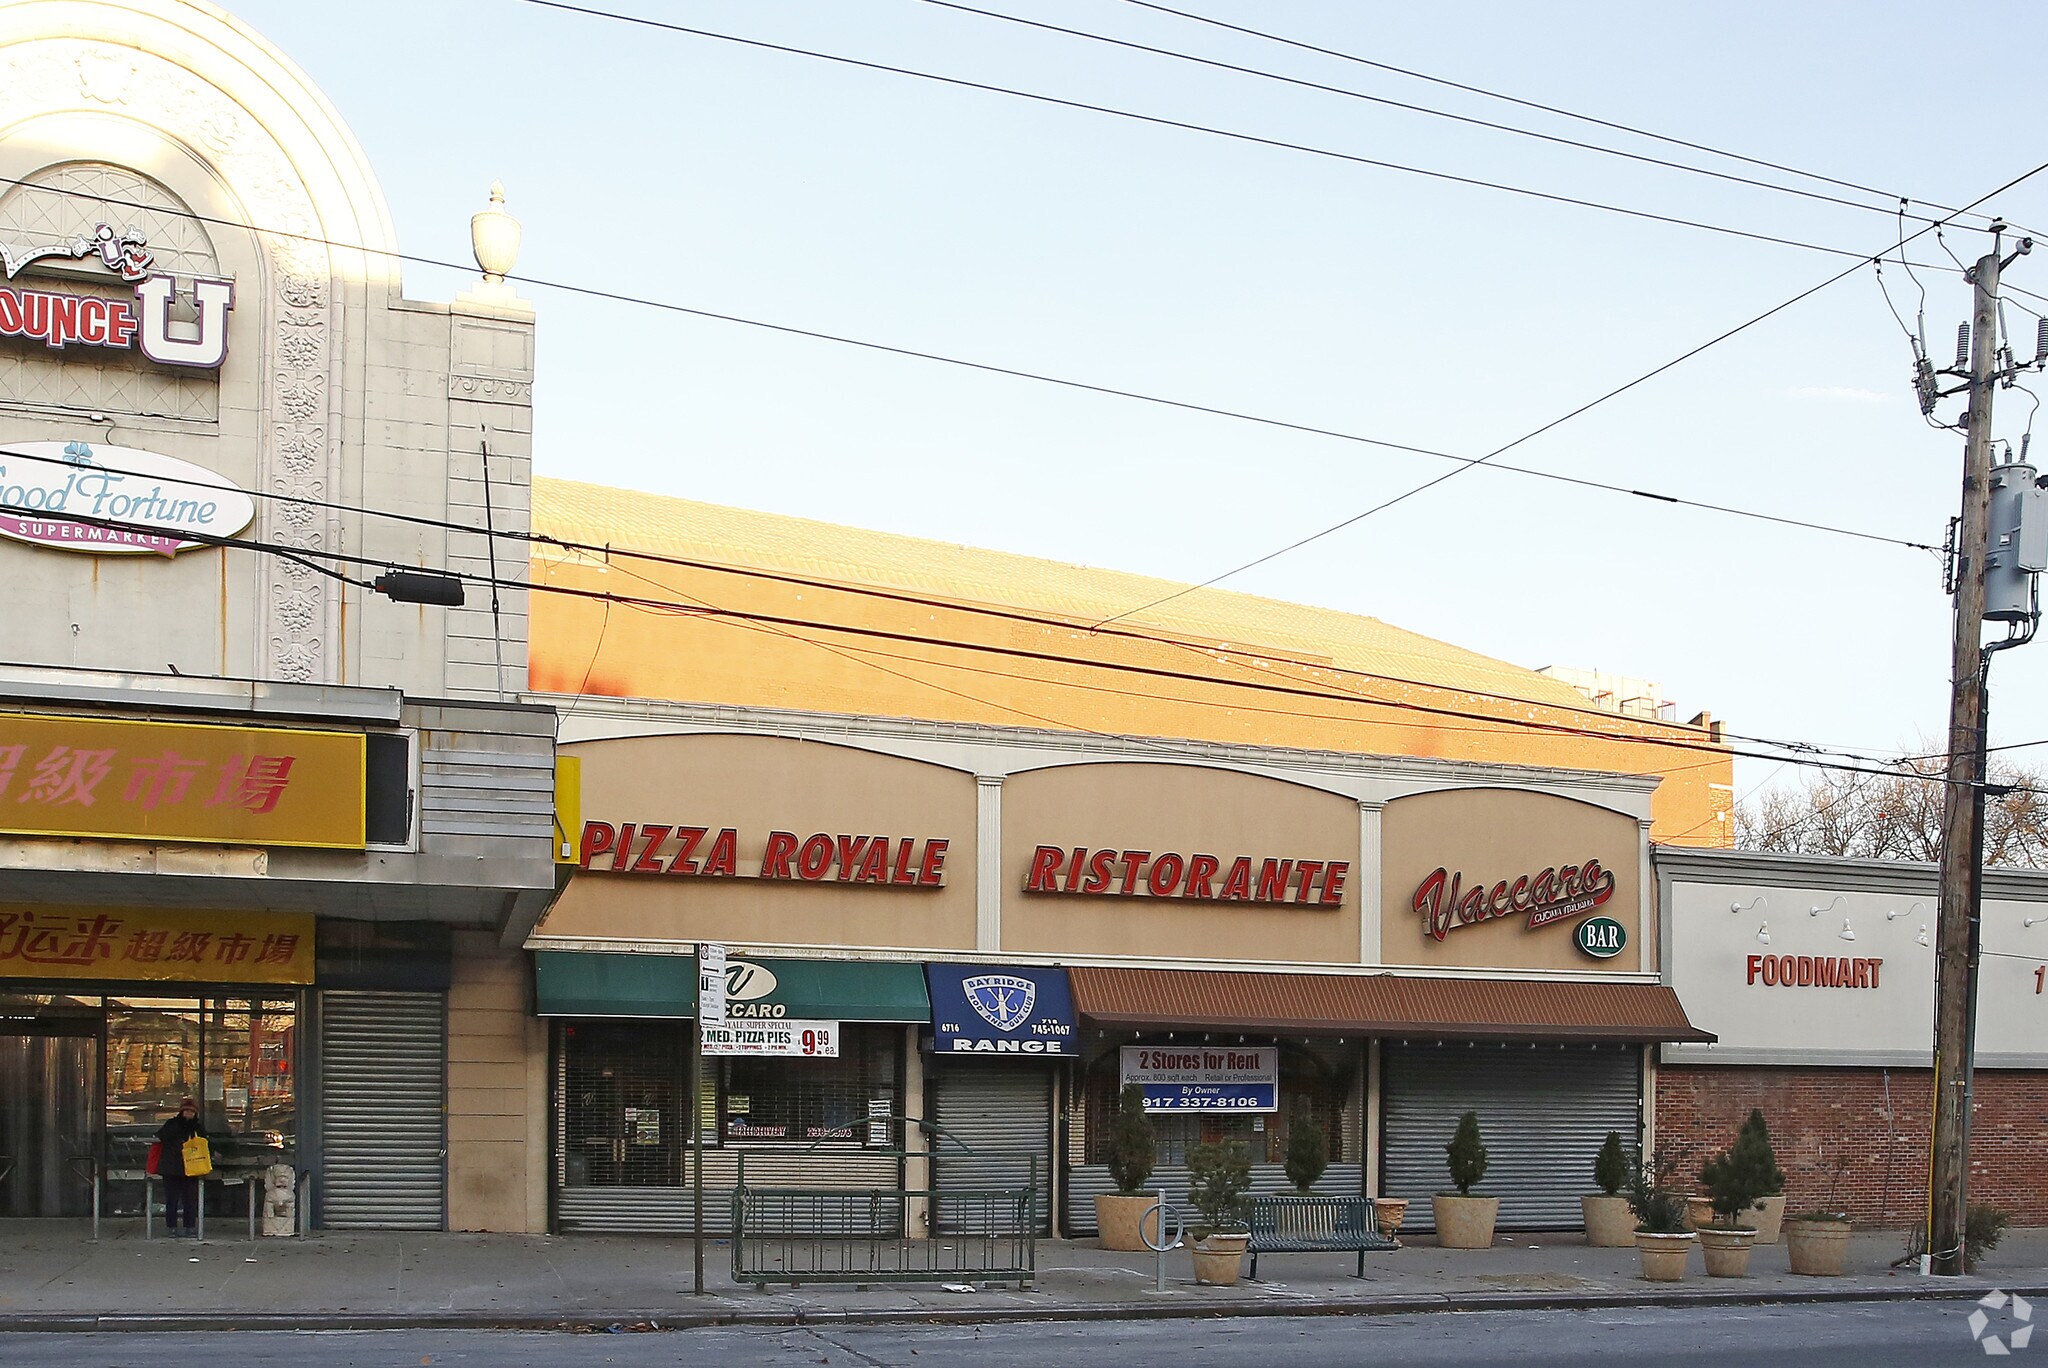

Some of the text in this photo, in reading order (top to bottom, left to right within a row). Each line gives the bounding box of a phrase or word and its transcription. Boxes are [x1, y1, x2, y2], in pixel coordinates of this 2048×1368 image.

[136, 275, 234, 367] U
[0, 466, 216, 524] ood Fortune
[18, 521, 172, 546] SUPERMARKET
[0, 745, 296, 814] 級市場
[581, 820, 949, 887] PIZZA ROYALE
[1027, 845, 1351, 907] RISTORANTE
[1412, 858, 1615, 942] Vaccaro
[1586, 924, 1620, 949] BAR
[1747, 954, 1883, 989] FOODMART
[967, 977, 1033, 990] BAY RIDGE
[968, 994, 1034, 1028] ROD AND GUN CLUB
[746, 1021, 766, 1029] SUPER
[768, 1021, 792, 1029] SPECIAL
[941, 1023, 960, 1033] 6716
[1032, 1024, 1070, 1035] 745-1067
[706, 1030, 791, 1044] MED. PIZZA PIES
[953, 1039, 1062, 1053] RANGE
[1139, 1050, 1260, 1070] 2 Stores for Rent
[1181, 1074, 1198, 1082] each
[1205, 1074, 1223, 1082] Retail
[1233, 1074, 1272, 1082] Professional
[1181, 1086, 1220, 1095] By Owner
[1142, 1097, 1258, 1107] 917 337-8106
[754, 1127, 786, 1137] DELIVERY
